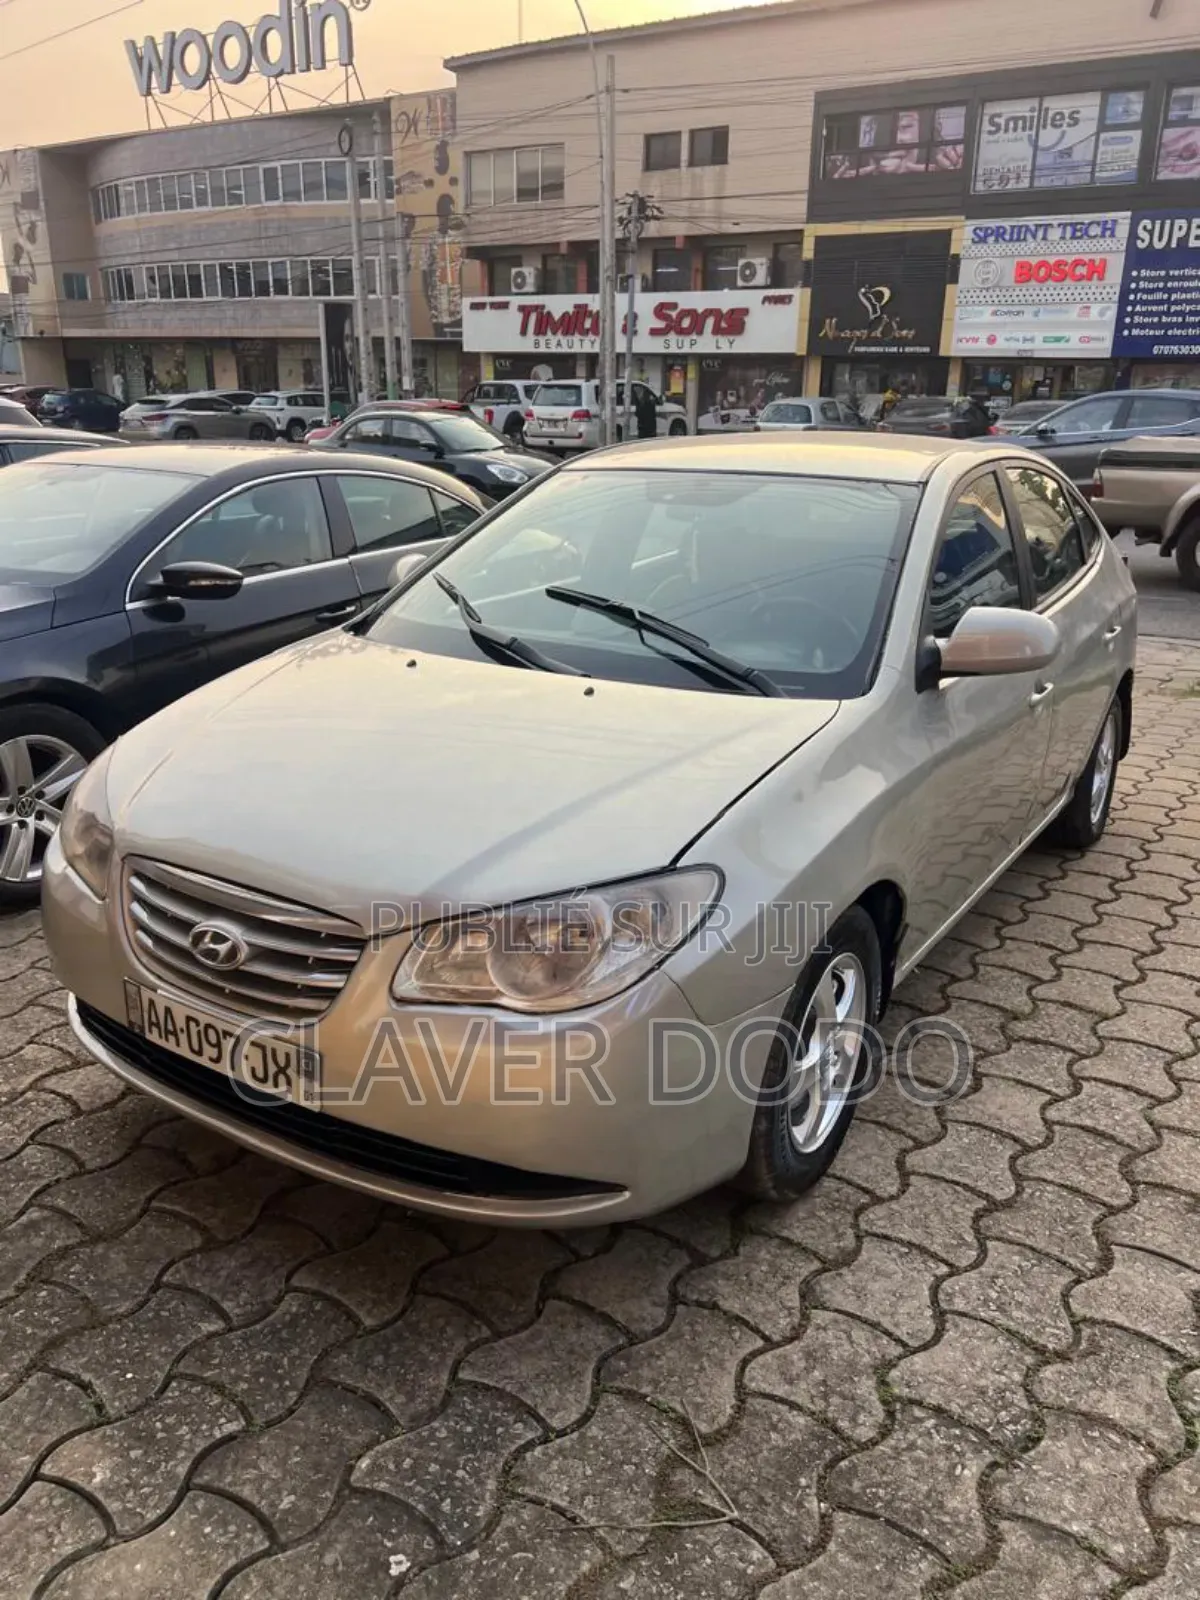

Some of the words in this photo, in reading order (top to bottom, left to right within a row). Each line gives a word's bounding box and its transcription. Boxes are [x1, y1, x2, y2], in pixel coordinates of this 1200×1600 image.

[124, 0, 353, 96] woodin
[986, 106, 1081, 135] Smiles
[1057, 219, 1119, 240] TECH
[1015, 259, 1108, 284] BOSCH
[1140, 268, 1166, 277] Store
[1138, 281, 1164, 289] Store
[648, 302, 750, 336] Sons
[1132, 315, 1159, 323] Store
[1131, 328, 1165, 336] Moteur
[533, 338, 597, 349] BEAUTY
